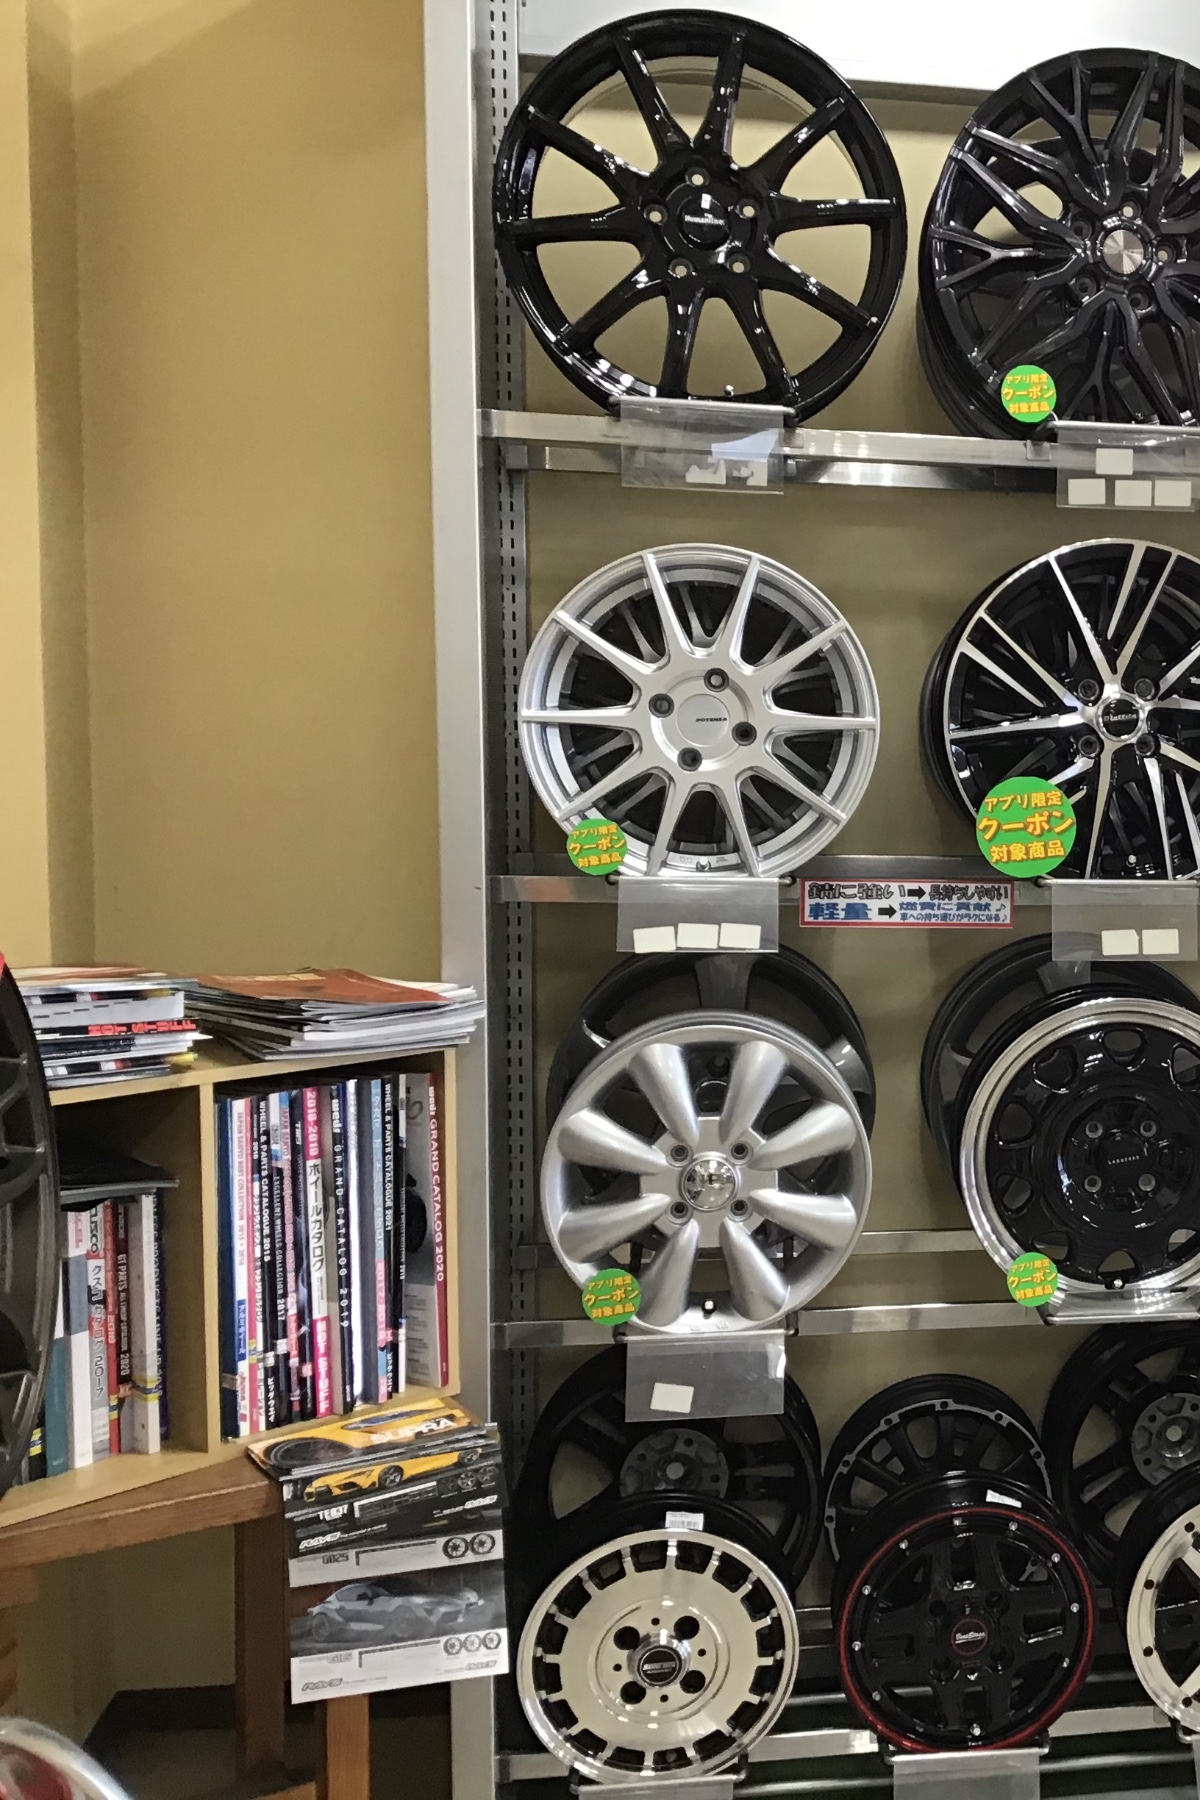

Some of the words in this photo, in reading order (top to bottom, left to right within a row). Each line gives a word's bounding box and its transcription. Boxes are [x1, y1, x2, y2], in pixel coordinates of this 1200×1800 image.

[1003, 385, 1055, 400] クーポン
[1006, 373, 1048, 385] アプリ限定
[1009, 401, 1050, 414] 対象商品
[984, 790, 1063, 812] アプリ限定
[571, 824, 618, 839] アプリ限定
[977, 810, 1074, 841] クーポン
[569, 836, 625, 855] クーポン
[577, 851, 622, 868] 対象商品
[989, 839, 1065, 863] 対象商品
[808, 882, 906, 900] 錆に強い
[928, 883, 1009, 901] 長持ちしやすい
[808, 902, 872, 920] 軽量
[898, 901, 991, 912] 燃費に貢献
[899, 912, 1001, 923] 車への持ち運びがラクになる
[87, 1023, 128, 1037] HOT
[131, 1018, 197, 1034] STUFF
[384, 1083, 392, 1114] WHEEL
[428, 1086, 437, 1115] weds
[259, 1101, 267, 1135] WHEEL
[306, 1091, 318, 1156] 2018-2019
[331, 1099, 341, 1134] weds
[384, 1124, 392, 1153] PARTS
[429, 1118, 440, 1171] GRAND
[260, 1145, 269, 1177] PARTS
[334, 1144, 344, 1197] GRAND
[384, 1154, 393, 1207] CATALOGUE
[237, 1179, 245, 1221] COLLECTION
[261, 1179, 270, 1237] CATALOGUE
[273, 1175, 281, 1217] EXCELLENT
[432, 1174, 443, 1243] CATALOG
[309, 1163, 323, 1271] ホイールカタログ
[385, 1208, 393, 1231] 2021
[275, 1218, 283, 1247] WHEELS
[336, 1207, 348, 1275] CATALOG
[117, 1253, 127, 1264] GT
[275, 1249, 283, 1295] COLLECTION
[435, 1243, 444, 1282] 2020
[1012, 1257, 1051, 1273] アプリ限定
[91, 1265, 104, 1302] クスコ
[117, 1265, 128, 1291] PARTS
[587, 1275, 632, 1290] アプリ限定
[1009, 1269, 1056, 1289] クーポン
[1015, 1284, 1053, 1300] 対象商品
[277, 1298, 285, 1321] 2017
[339, 1288, 349, 1328] 2019
[584, 1287, 639, 1306] クーポン
[591, 1302, 635, 1319] 対象商品
[316, 1320, 328, 1350] HOT
[94, 1356, 105, 1400] 2017
[120, 1353, 130, 1376] 2020
[317, 1358, 330, 1414] STUFF
[369, 1417, 458, 1445] SUPRA
[317, 1503, 349, 1521] TE037
